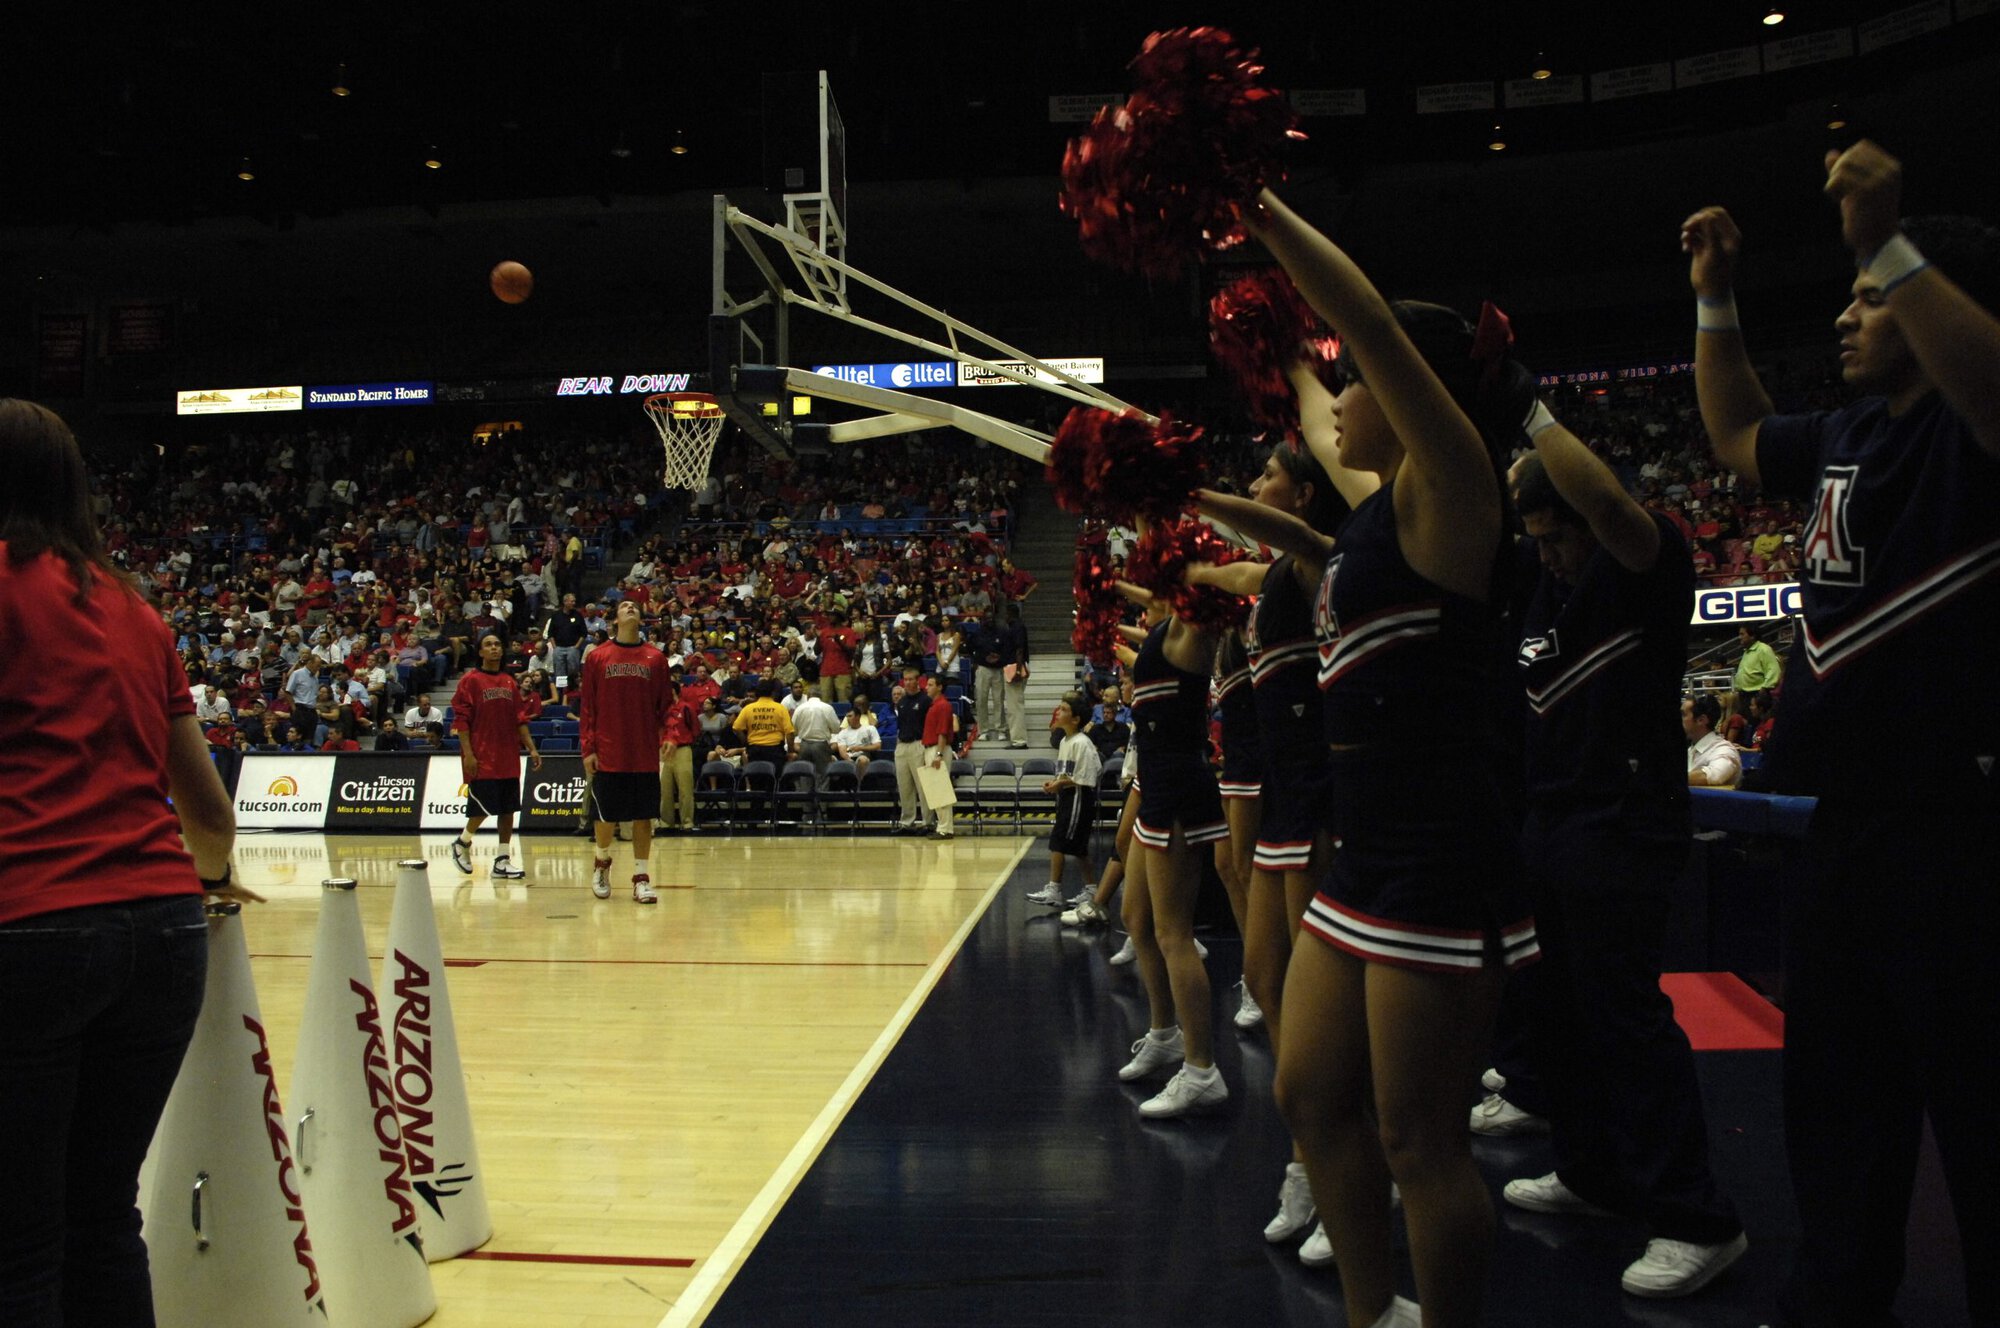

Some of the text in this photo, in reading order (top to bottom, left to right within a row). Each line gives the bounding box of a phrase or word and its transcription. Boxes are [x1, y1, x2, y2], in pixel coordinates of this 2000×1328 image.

[556, 373, 690, 396] BEAR DOWN
[891, 363, 952, 387] alltel
[1540, 370, 1610, 386] ARZONA
[309, 390, 357, 403] STANDARD
[357, 388, 392, 401] PACIFIC
[395, 386, 429, 400] HOMES
[1803, 465, 1865, 587] A
[605, 663, 652, 681] ARIZONA
[340, 780, 415, 802] Citizen
[378, 775, 416, 787] Tucson
[239, 800, 322, 812] tucson.com
[336, 805, 354, 813] Miss
[394, 948, 434, 1176] ARIZONA
[349, 978, 416, 1233] ARIZONA
